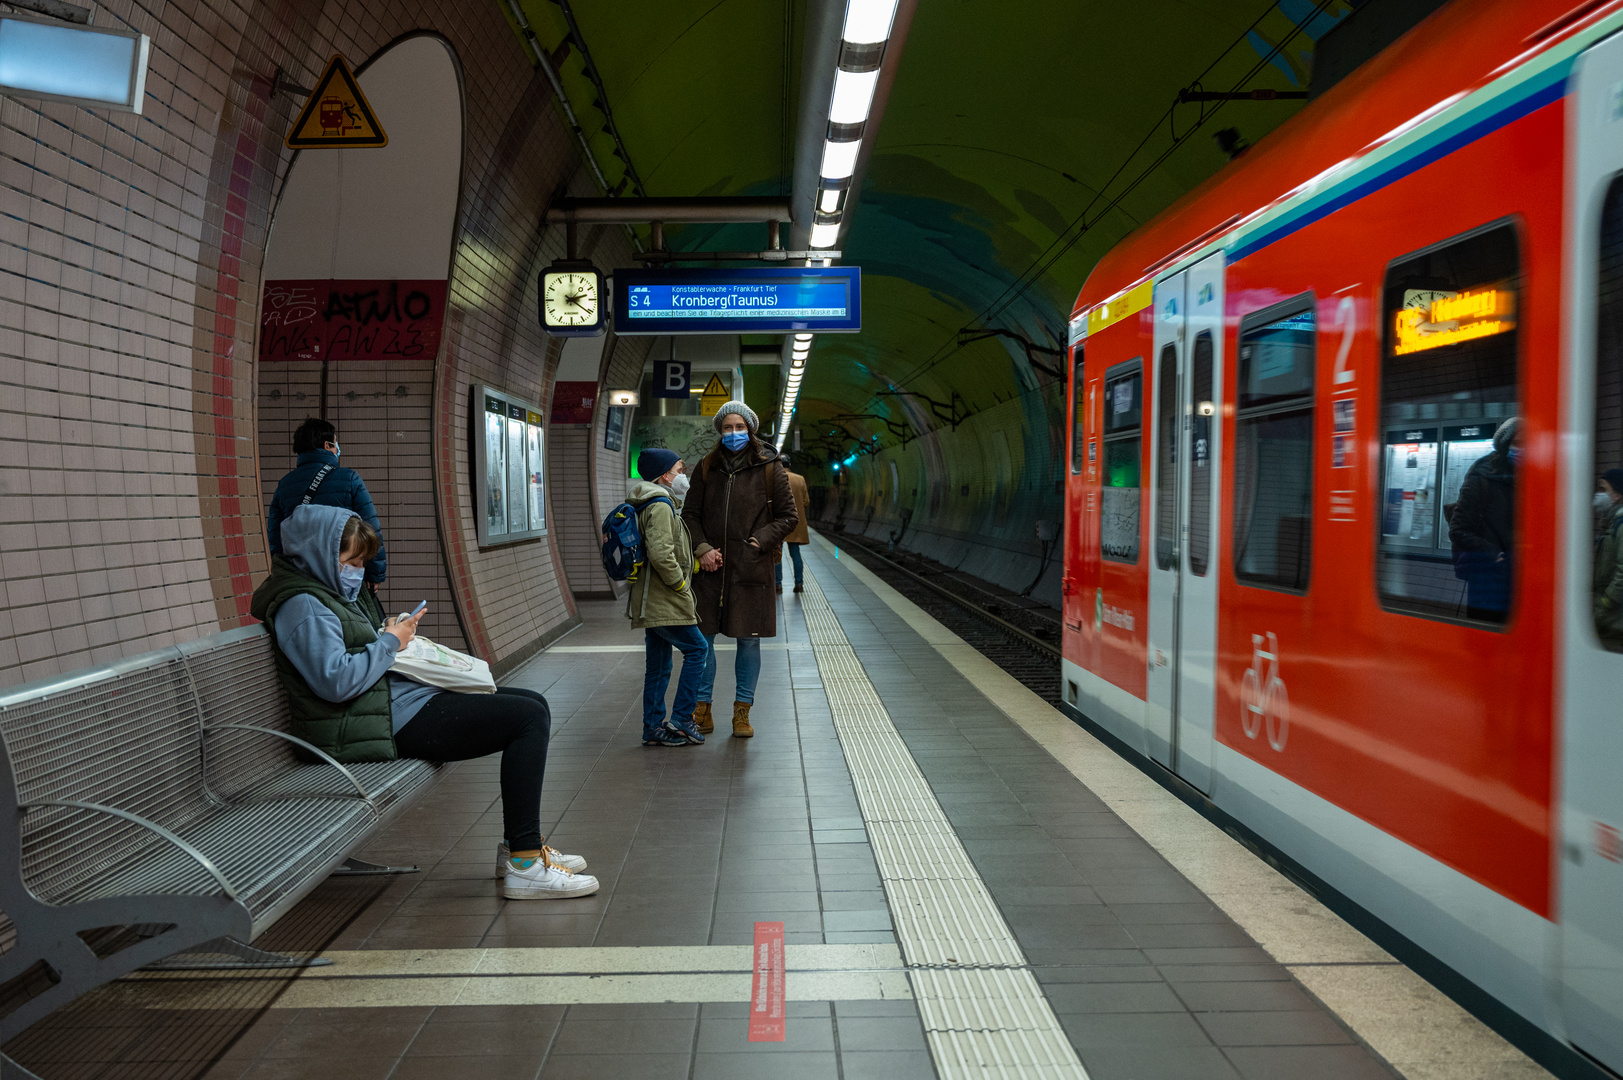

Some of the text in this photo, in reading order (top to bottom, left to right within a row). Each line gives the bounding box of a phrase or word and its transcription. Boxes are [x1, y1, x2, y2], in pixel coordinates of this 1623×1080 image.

[672, 285, 727, 293] Konstablerwache
[733, 285, 763, 293] Frankfurt
[630, 295, 651, 307] S 4
[672, 294, 778, 309] Kronberg(Taunus)
[1333, 295, 1356, 386] 2
[665, 362, 686, 391] B
[309, 469, 327, 491] FREAKY
